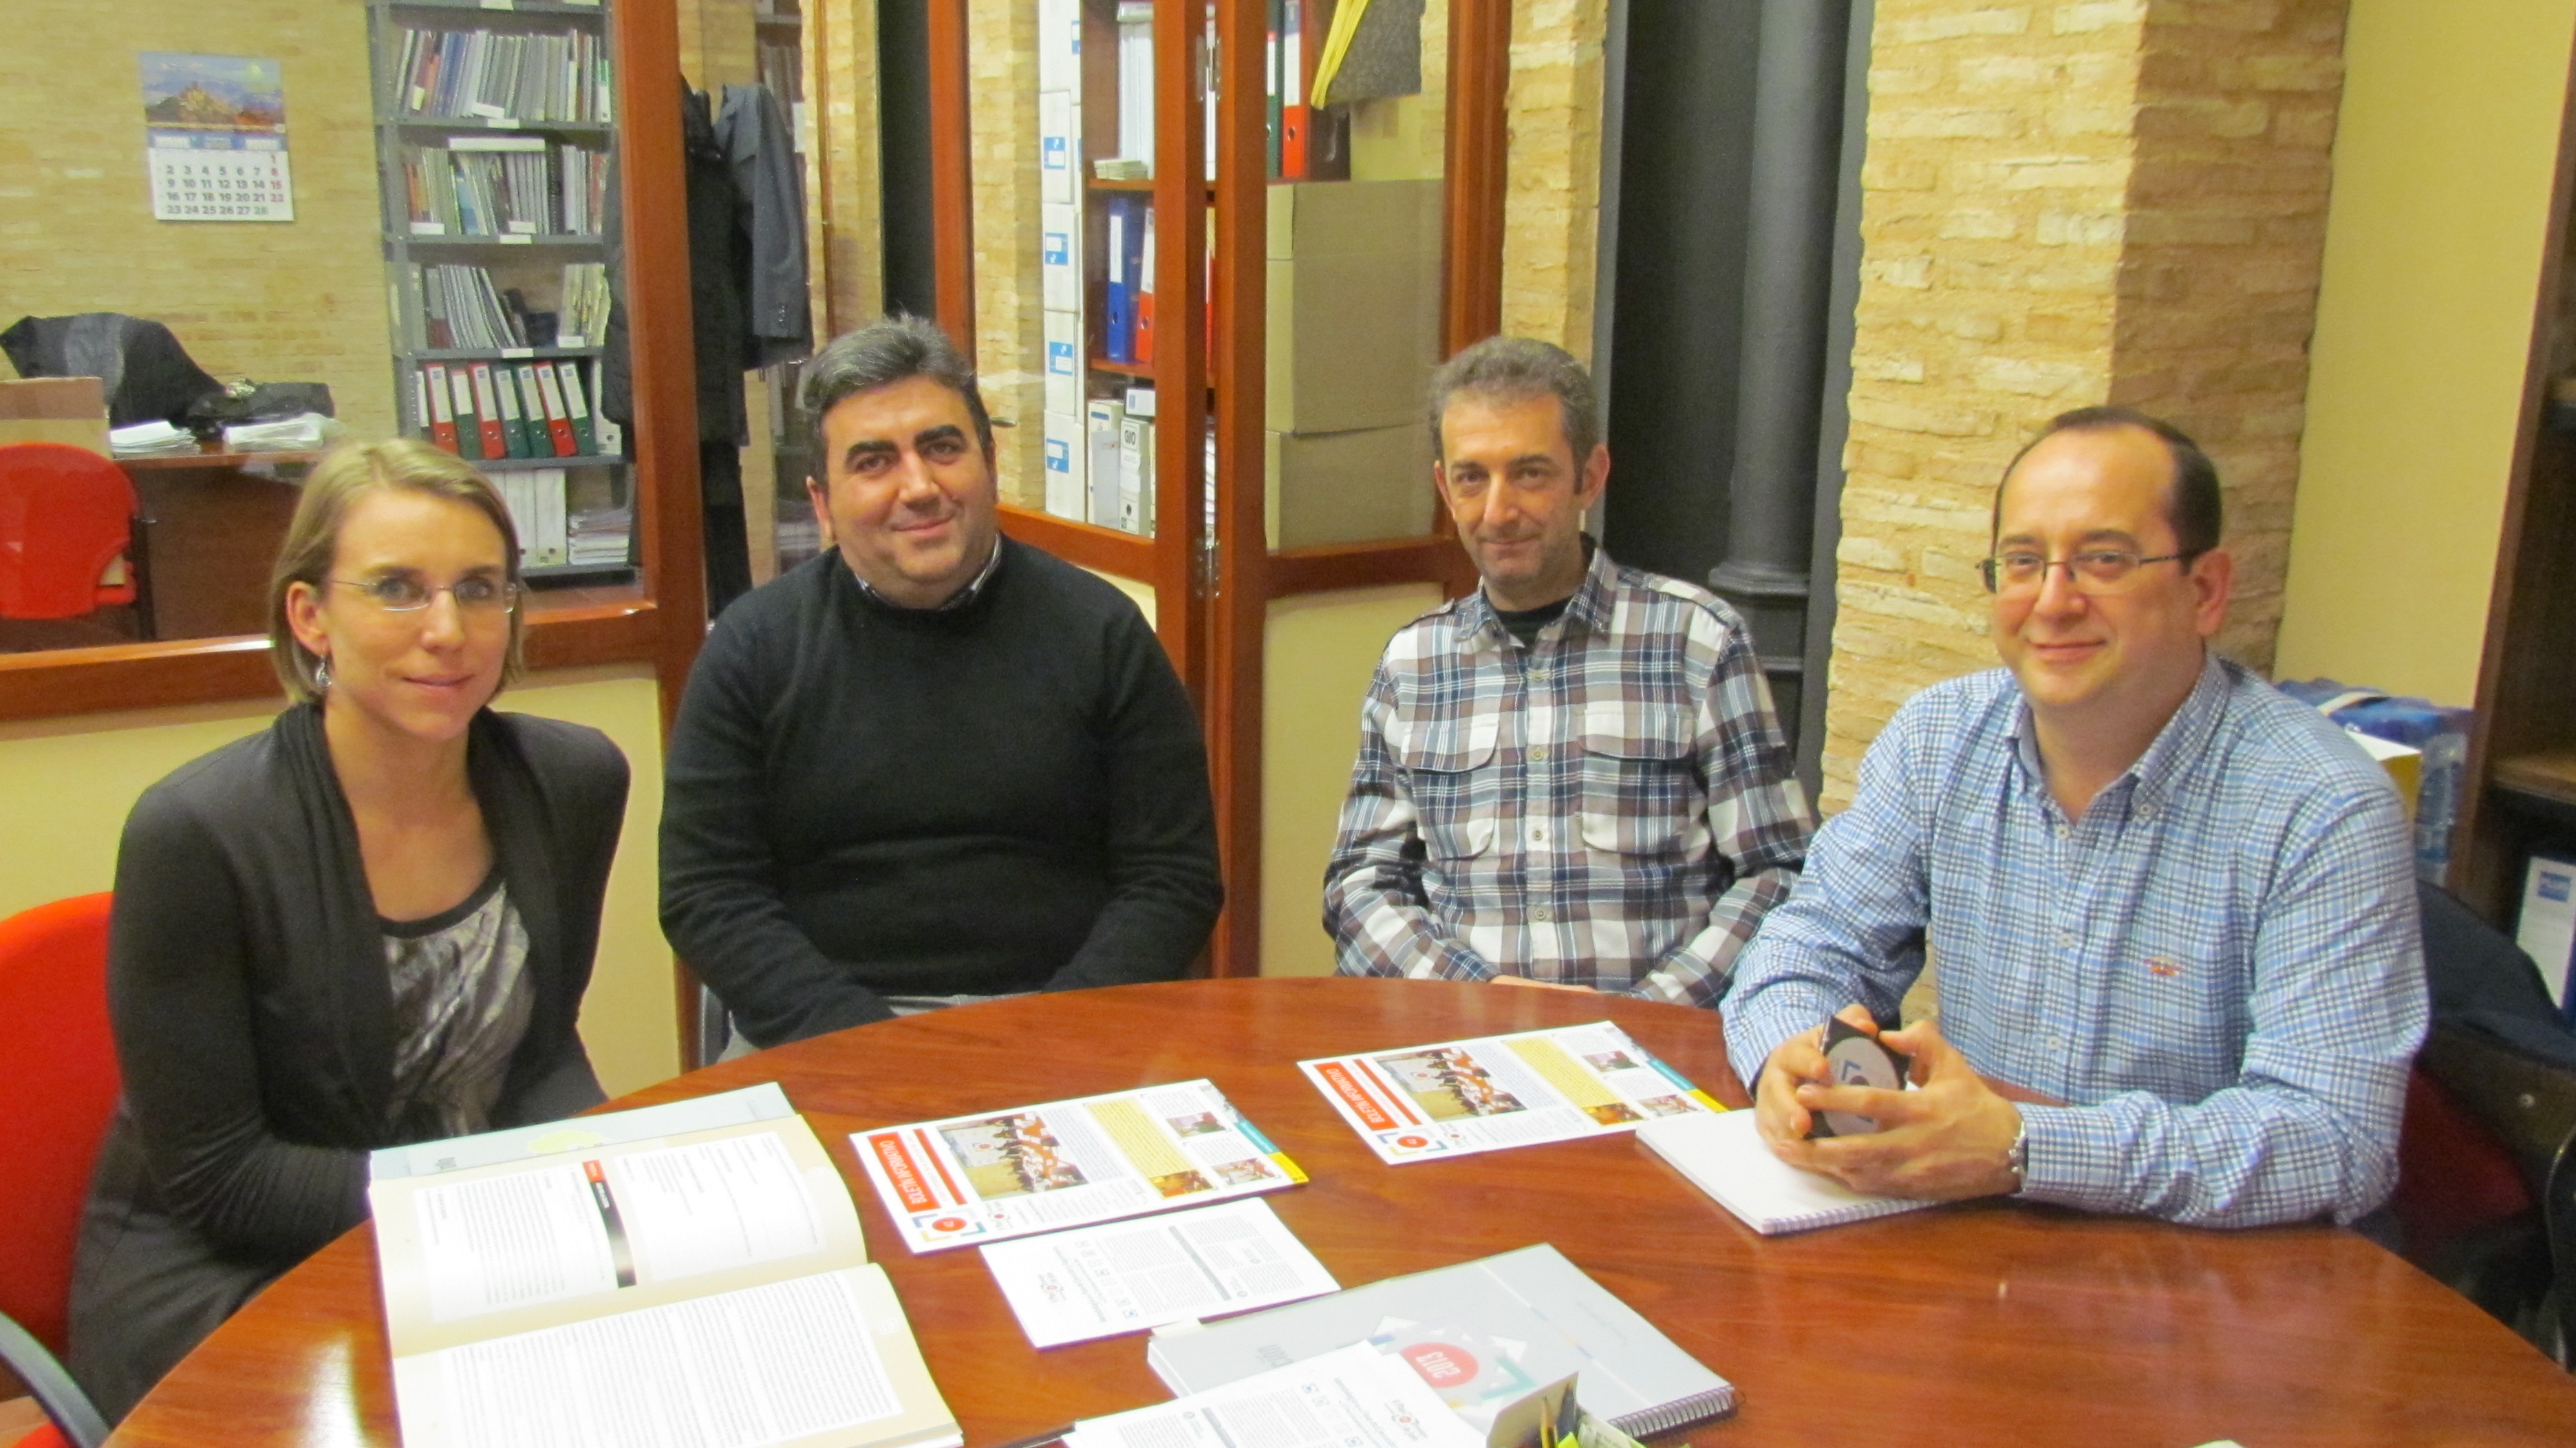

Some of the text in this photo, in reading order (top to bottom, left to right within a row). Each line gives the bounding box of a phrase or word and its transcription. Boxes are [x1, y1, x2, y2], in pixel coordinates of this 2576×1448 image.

[271, 155, 275, 163] 1
[167, 166, 174, 174] 2
[184, 166, 191, 174] 3
[219, 167, 226, 175] 5
[237, 167, 244, 175] 6
[168, 179, 175, 187] 9
[184, 179, 196, 188] 10
[201, 180, 212, 188] 11
[218, 180, 230, 189] 12
[236, 180, 248, 189] 13
[253, 180, 265, 189] 14
[167, 192, 283, 202] 16 17 18 19 20 21 22
[167, 206, 181, 214] 23
[184, 206, 199, 214] 24
[237, 206, 250, 215] 27
[255, 206, 268, 215] 28
[1325, 1068, 1366, 1102] INFORMATIVO
[1355, 1101, 1385, 1122] BOLETÍN
[879, 1140, 914, 1179] INFORMATIVO
[898, 1178, 927, 1204] BOLETÍN
[1415, 1351, 1461, 1378] 2013
